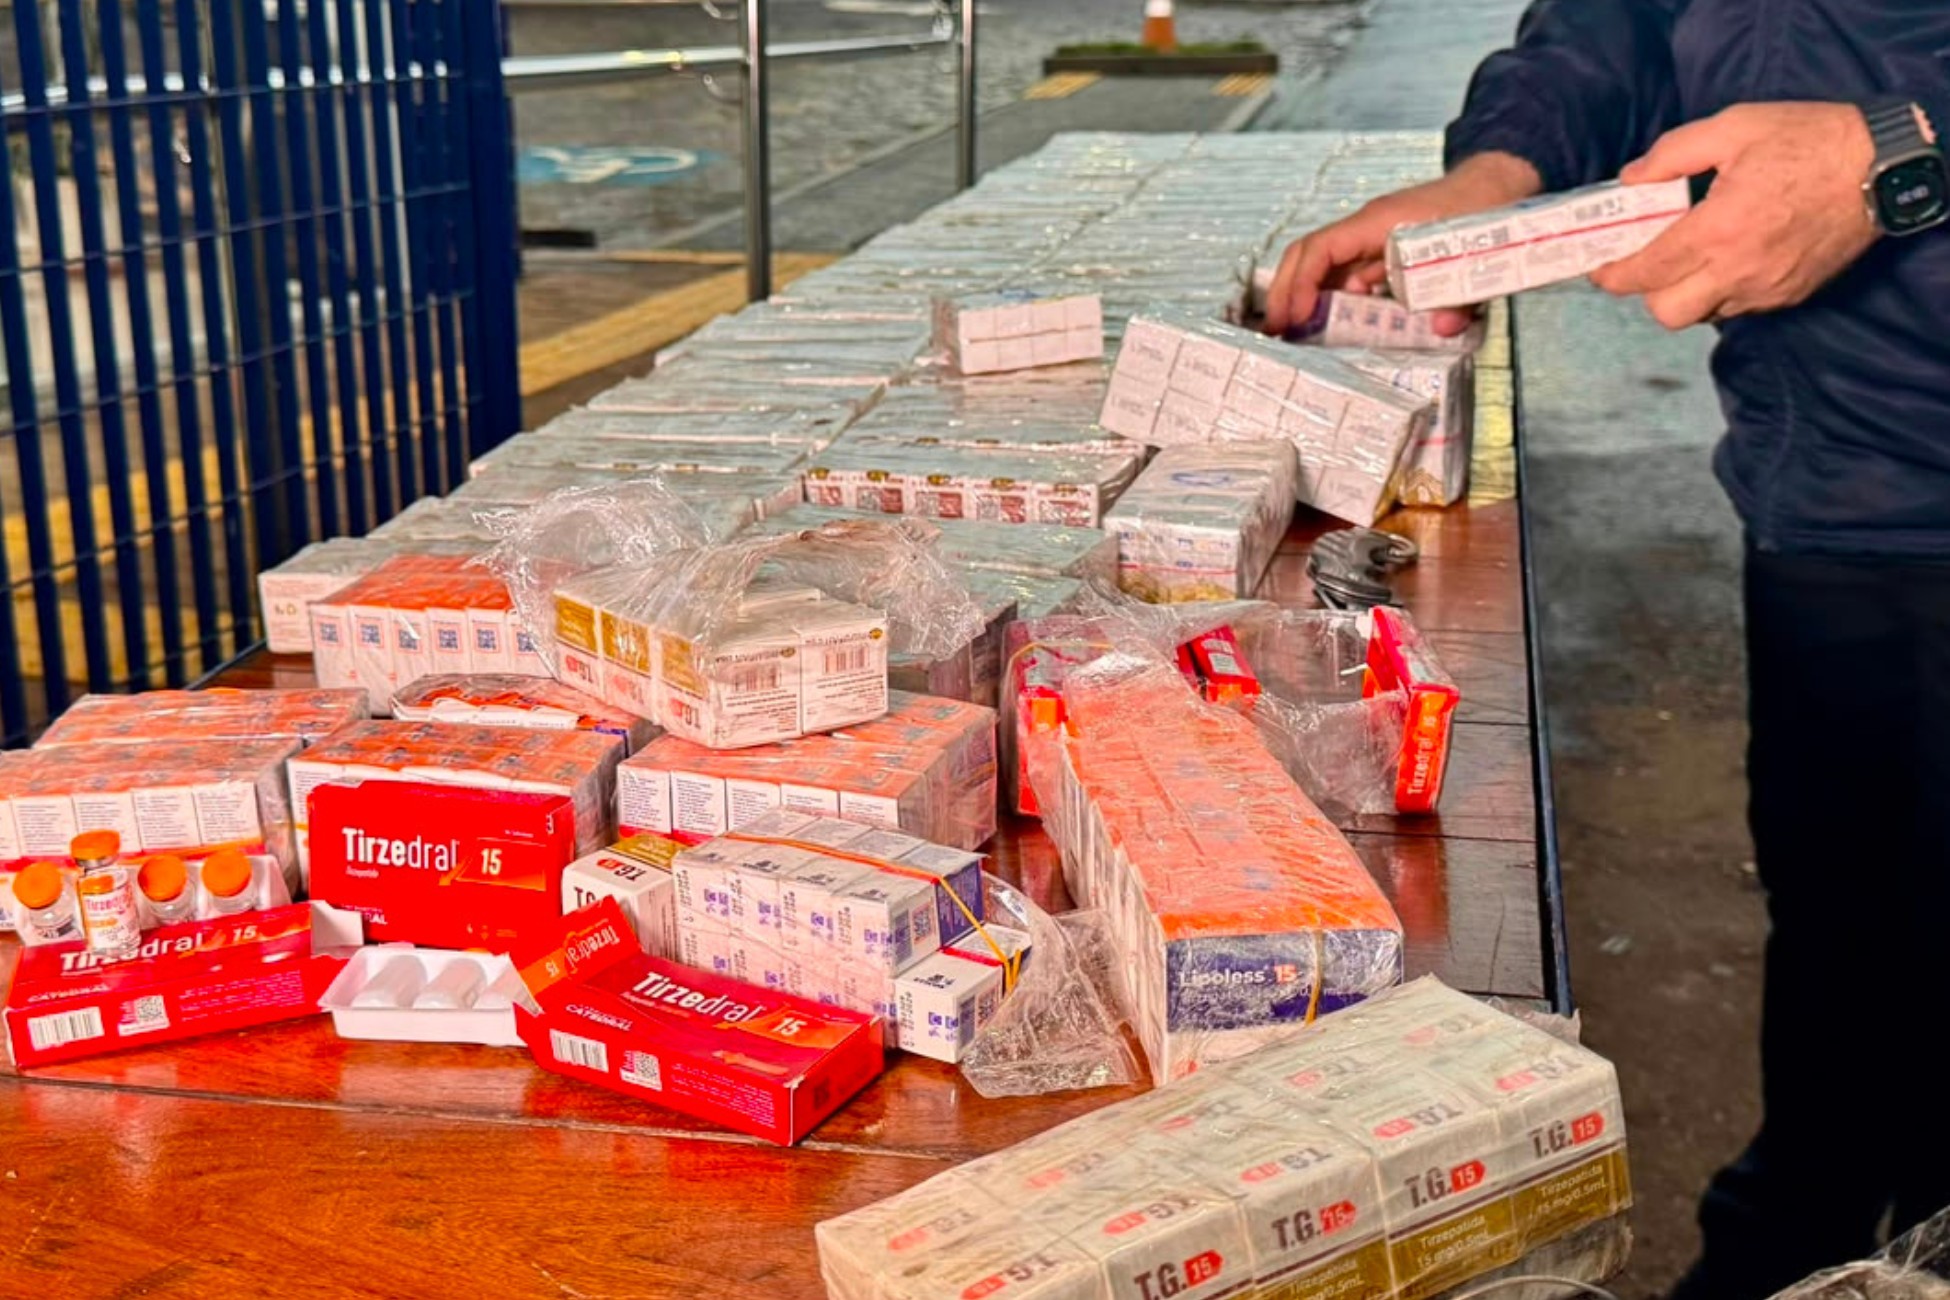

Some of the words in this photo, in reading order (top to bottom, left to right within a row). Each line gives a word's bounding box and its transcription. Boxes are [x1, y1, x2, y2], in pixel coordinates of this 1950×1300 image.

[342, 827, 459, 871] Tirzedral
[481, 848, 502, 875] 15
[232, 926, 257, 942] 15
[566, 925, 620, 966] Tirzedral
[1180, 967, 1263, 988] Lipoless
[1274, 963, 1298, 984] 15
[632, 971, 765, 1023] Tirzedral
[771, 1017, 807, 1037] 15
[1529, 1120, 1573, 1158] T.G.
[1576, 1116, 1597, 1139] 15
[1404, 1167, 1452, 1208] T.G.
[1456, 1163, 1477, 1188] 15
[1272, 1210, 1321, 1250] T.G.
[1323, 1204, 1350, 1233] 15
[1134, 1262, 1187, 1300] T.G.
[1191, 1256, 1212, 1281] 15
